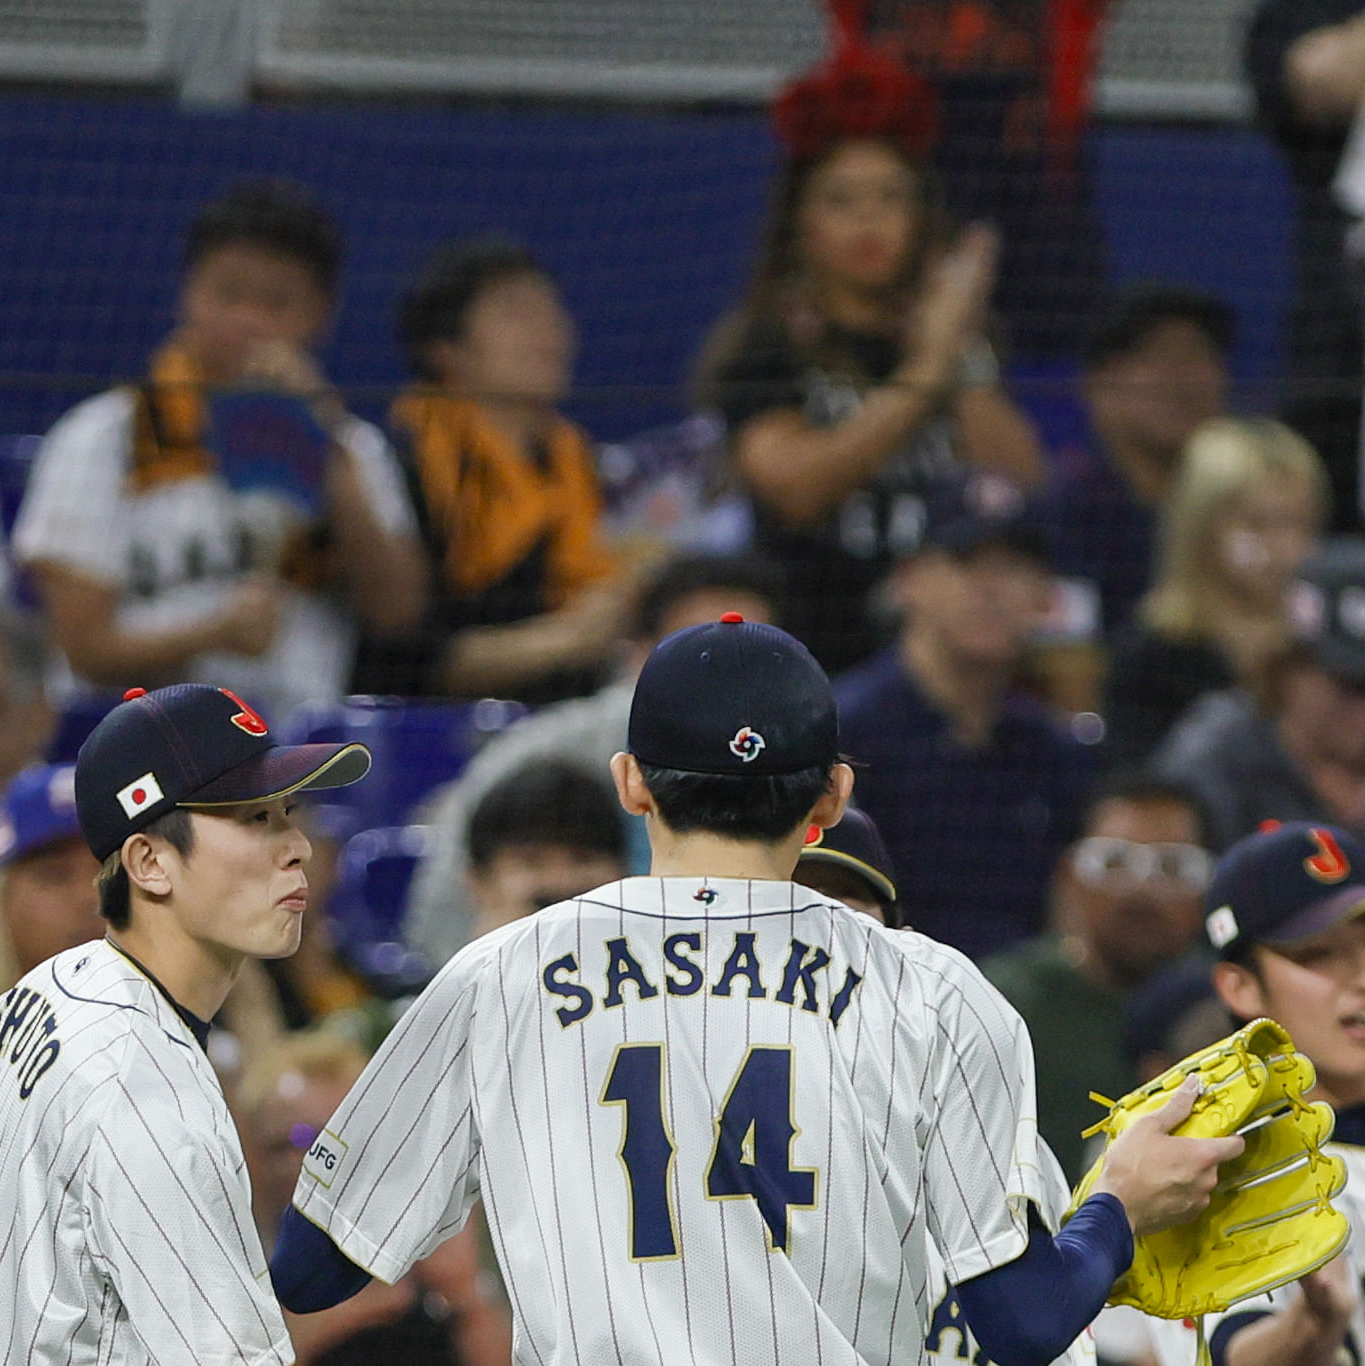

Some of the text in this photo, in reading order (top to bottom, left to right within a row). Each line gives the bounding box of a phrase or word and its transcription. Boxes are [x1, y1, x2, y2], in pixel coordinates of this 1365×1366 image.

[218, 688, 268, 737] J
[1302, 828, 1351, 884] J
[543, 931, 863, 1029] SASAKI
[597, 1041, 821, 1263] 14
